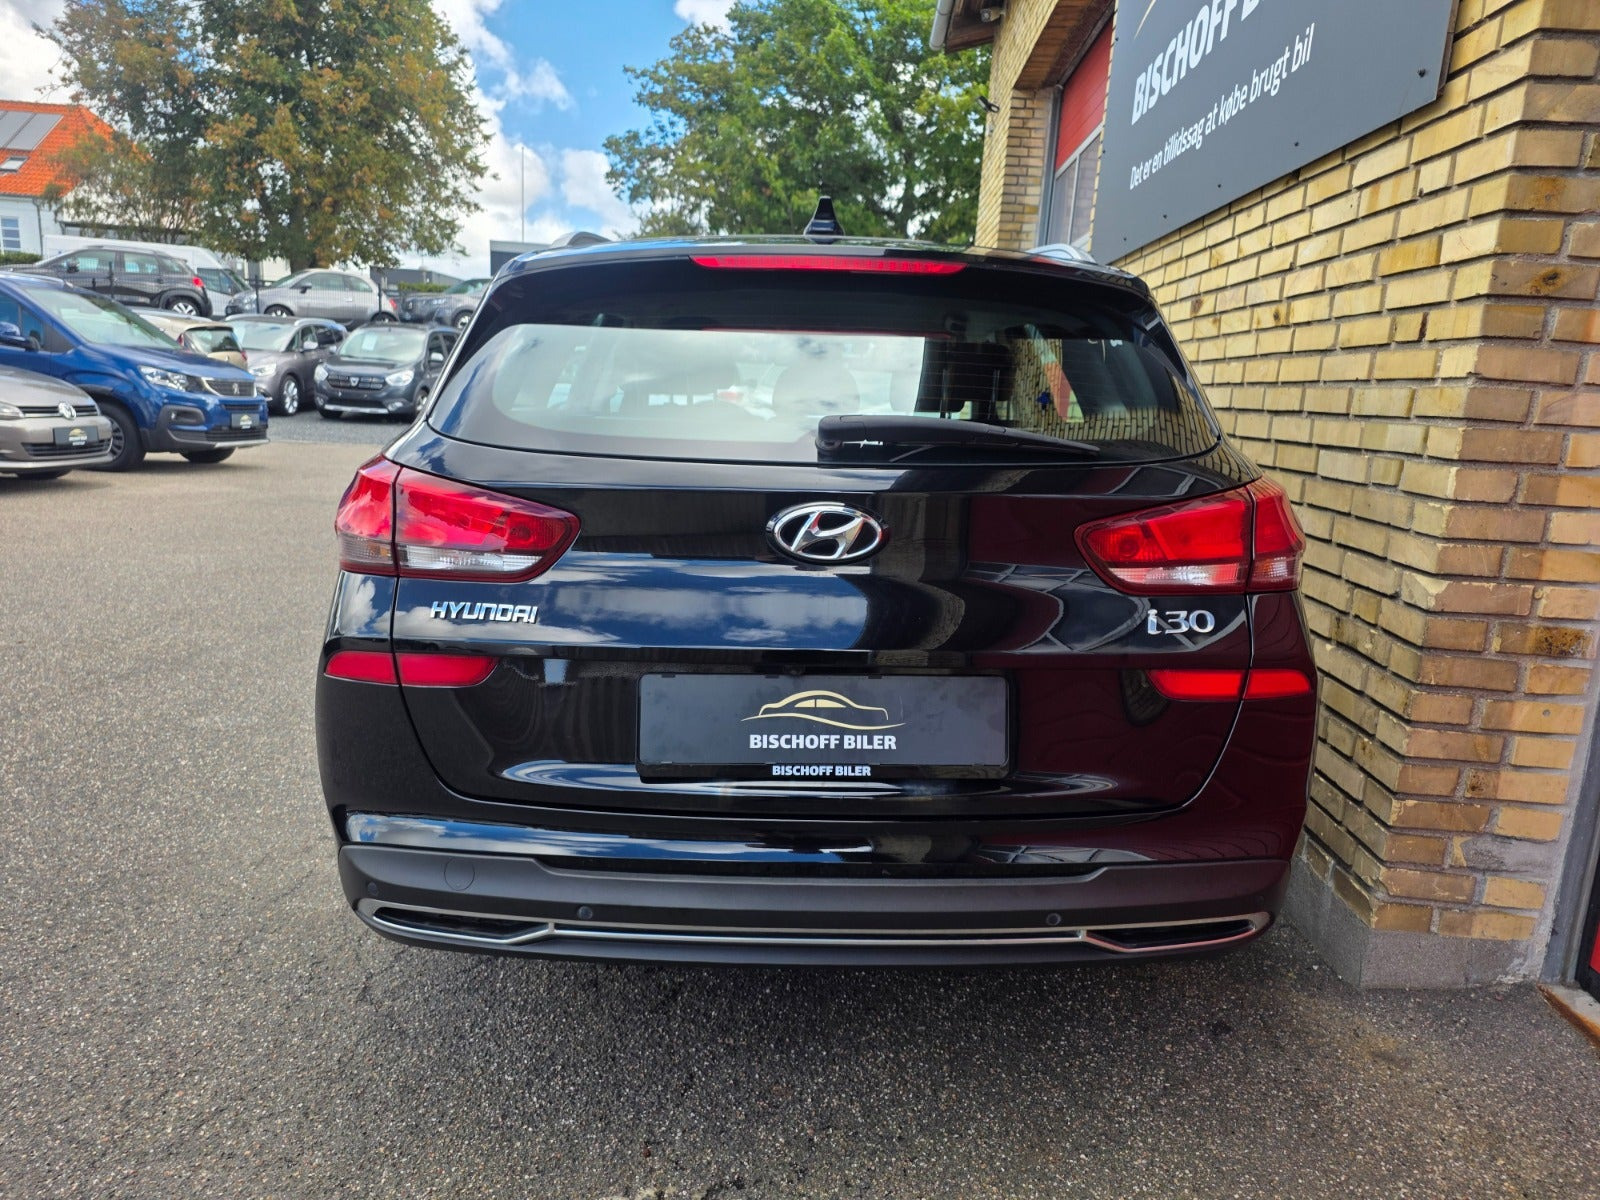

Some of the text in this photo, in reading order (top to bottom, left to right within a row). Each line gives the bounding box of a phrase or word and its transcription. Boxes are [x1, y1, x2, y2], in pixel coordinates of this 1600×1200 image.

[1129, 22, 1315, 190] Det er en tillidssag at købe brugt bil
[430, 600, 538, 624] HYUNDAI
[1147, 608, 1215, 635] i30
[749, 734, 897, 750] BISCHOFF BILER
[772, 765, 871, 776] BISCHOFF BILER
